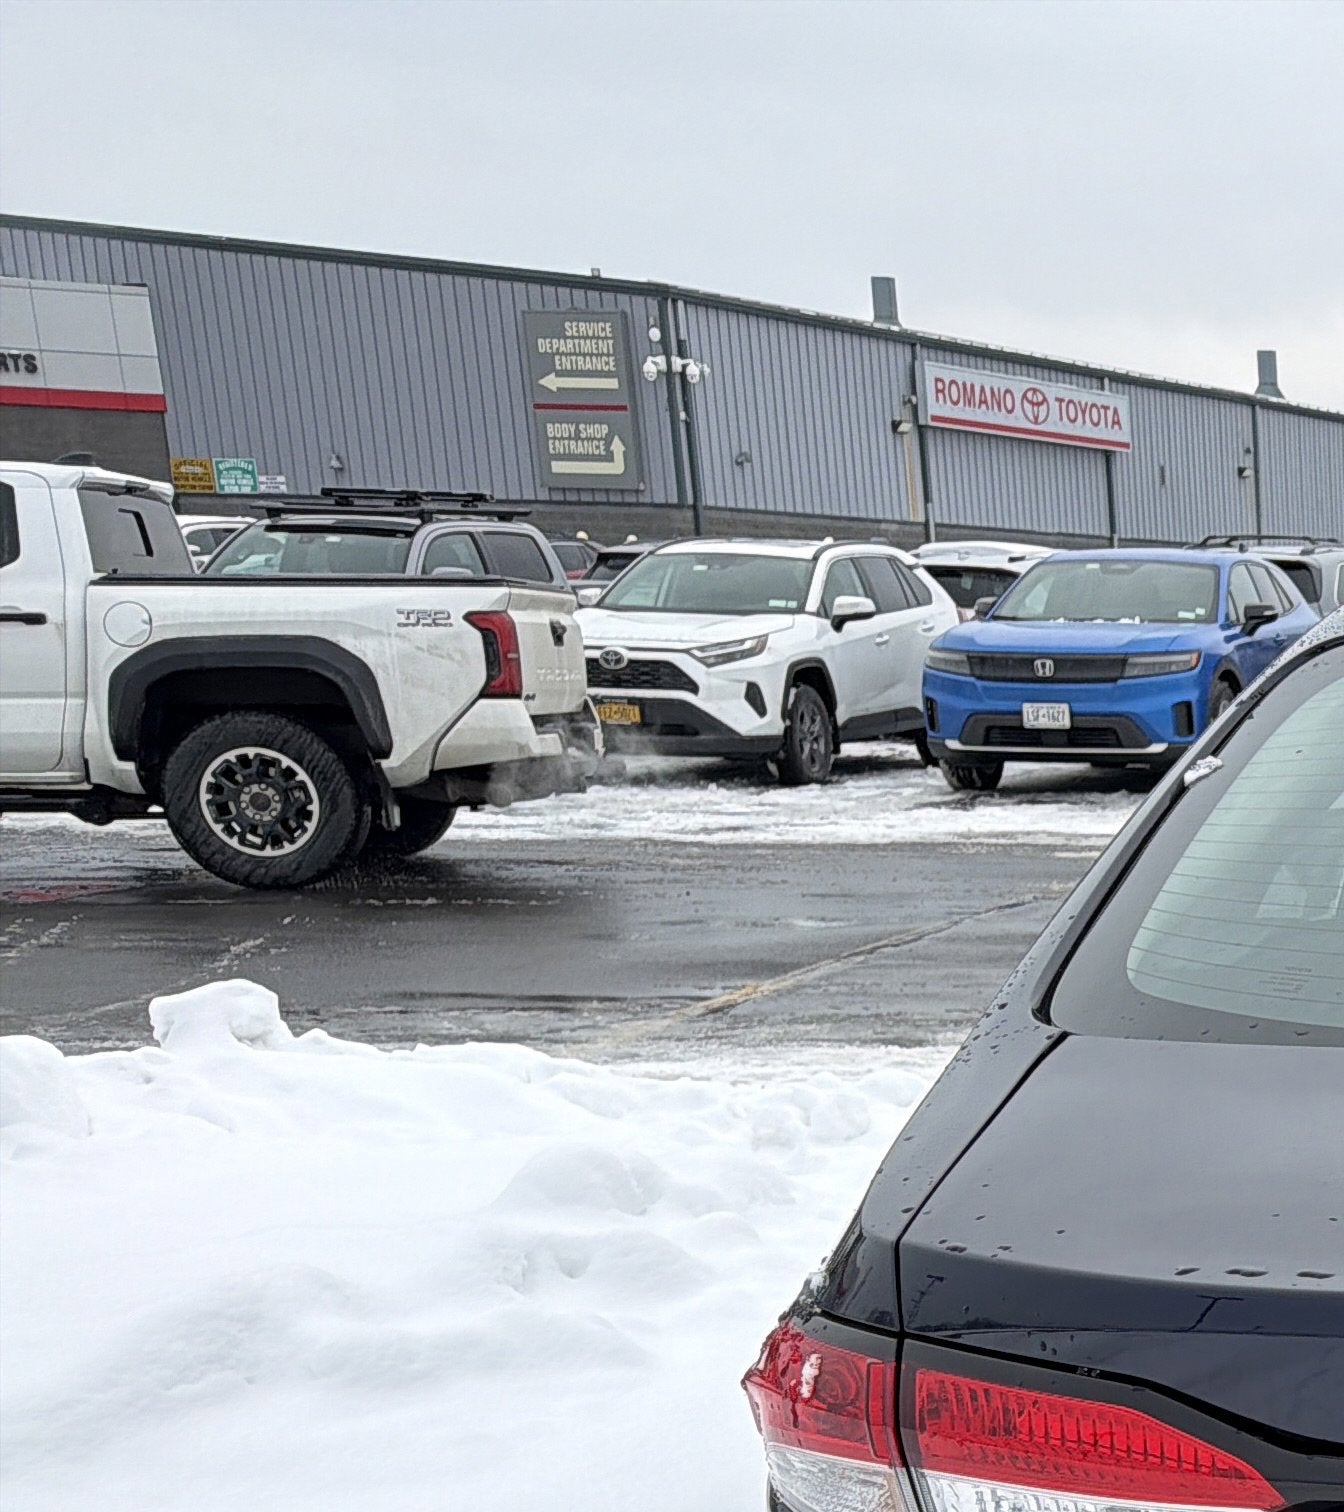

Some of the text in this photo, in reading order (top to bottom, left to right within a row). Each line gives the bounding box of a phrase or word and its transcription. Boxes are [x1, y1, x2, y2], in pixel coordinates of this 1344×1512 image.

[564, 320, 612, 337] SERVICE
[537, 337, 614, 354] DEPARTMENT
[554, 354, 616, 371] ENTRANCE
[934, 376, 1123, 431] ROMANO TOYOTA
[546, 422, 608, 439] BODY SHOP
[548, 439, 607, 455] ENTRANCE
[396, 608, 452, 624] TRD
